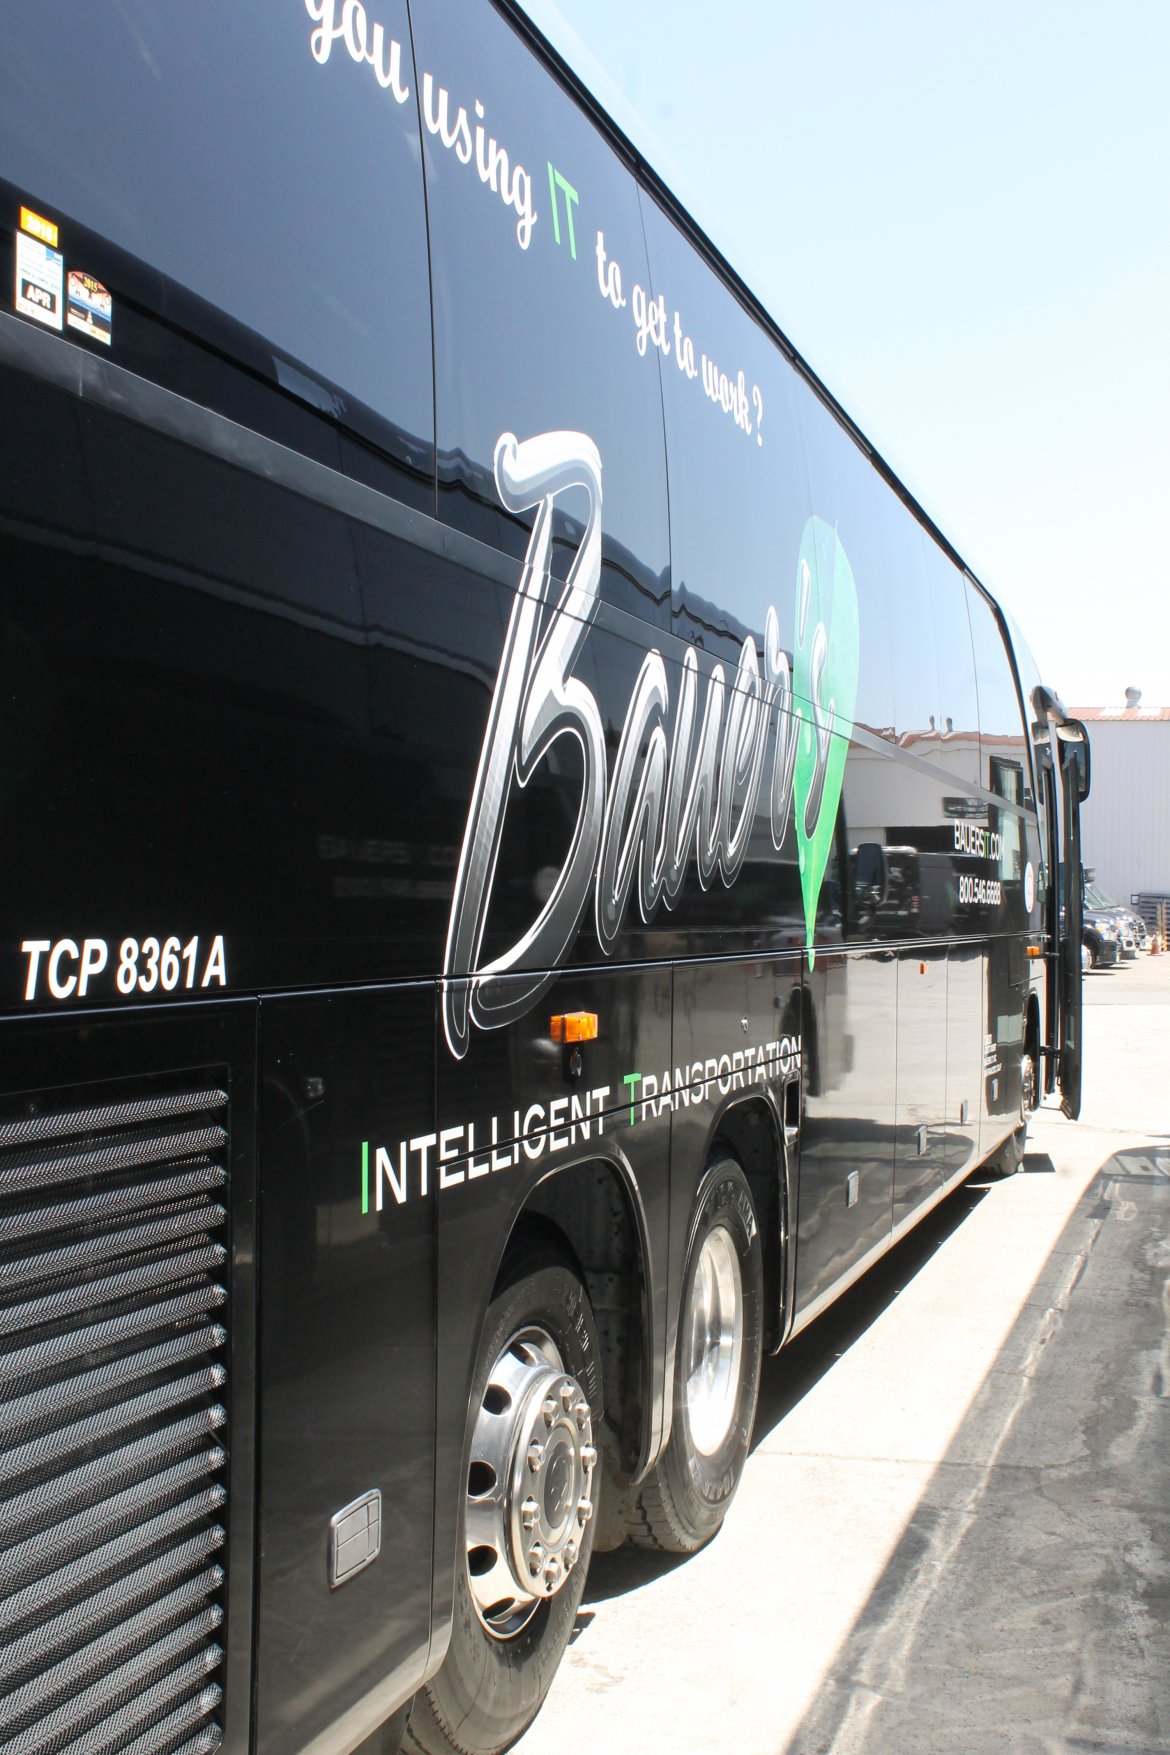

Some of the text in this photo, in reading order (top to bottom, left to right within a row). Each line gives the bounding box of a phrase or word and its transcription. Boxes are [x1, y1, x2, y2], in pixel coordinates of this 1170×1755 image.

[423, 72, 537, 250] using
[546, 160, 579, 260] IT
[596, 231, 627, 307] to
[632, 284, 671, 356] get
[673, 311, 698, 379] to
[26, 285, 52, 309] APR
[21, 935, 227, 1000] TCP 8361A
[361, 1086, 611, 1215] INTELLIGENT
[623, 1035, 802, 1126] TRANSPORTATION
